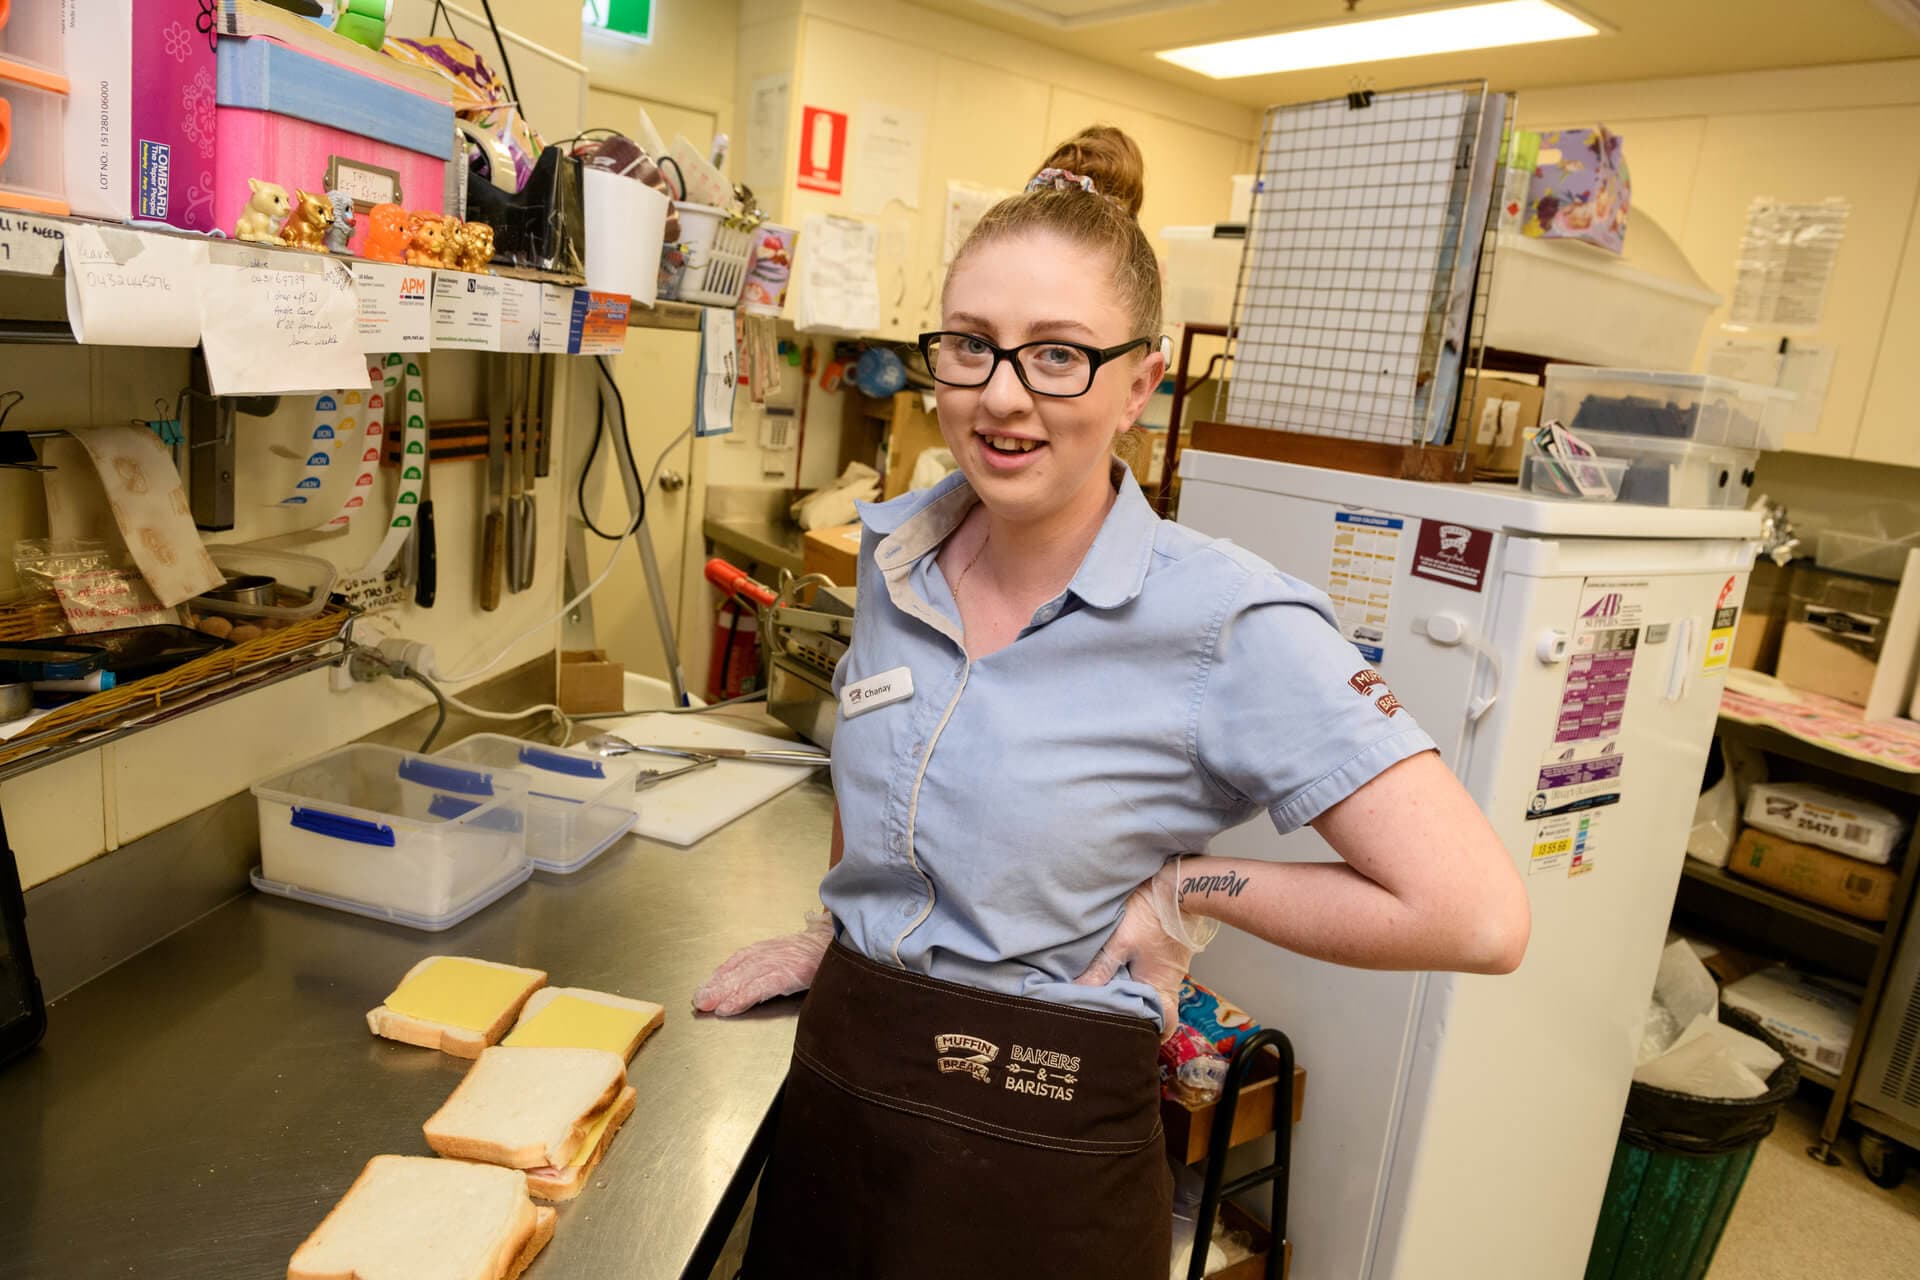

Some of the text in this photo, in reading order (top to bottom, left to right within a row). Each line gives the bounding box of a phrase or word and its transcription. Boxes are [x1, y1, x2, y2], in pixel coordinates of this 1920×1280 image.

[100, 172, 108, 190] LOT
[149, 162, 158, 186] Paper
[157, 145, 169, 217] LOMBARD
[149, 187, 158, 216] People
[17, 221, 29, 232] IF
[32, 225, 65, 240] NEED
[400, 277, 426, 295] APM
[864, 684, 891, 698] Chanay
[1182, 870, 1250, 899] Marlene
[943, 1036, 993, 1055] MUFFIN
[1010, 1044, 1081, 1073] BAKERS
[943, 1060, 986, 1077] BREAK
[1036, 1067, 1048, 1081] &
[1005, 1076, 1075, 1101] BARISTAS
